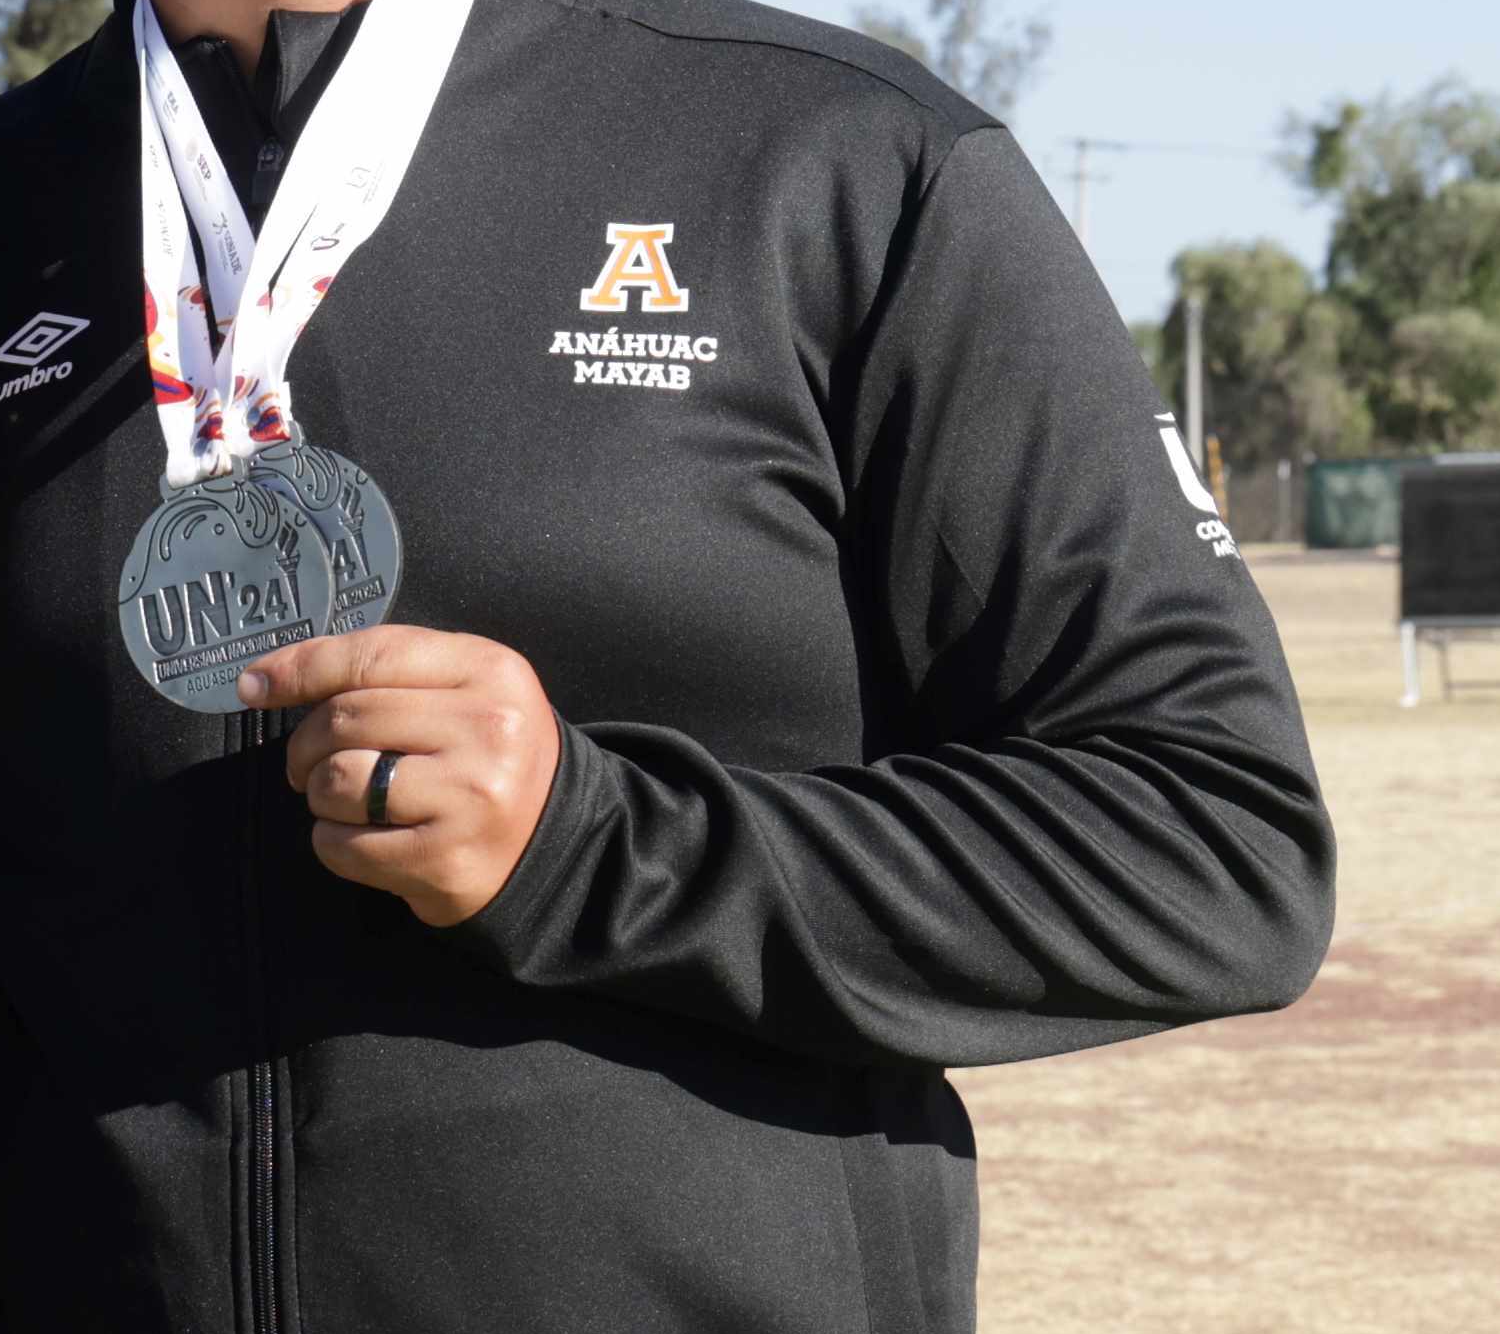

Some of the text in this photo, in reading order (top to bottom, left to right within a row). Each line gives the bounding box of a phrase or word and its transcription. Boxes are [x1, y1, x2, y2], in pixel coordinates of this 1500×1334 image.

[580, 222, 690, 313] A
[549, 326, 719, 362] ANÁHUAC
[573, 360, 691, 391] MAYAB
[226, 632, 277, 660] NACIONAL
[279, 623, 313, 646] 2024
